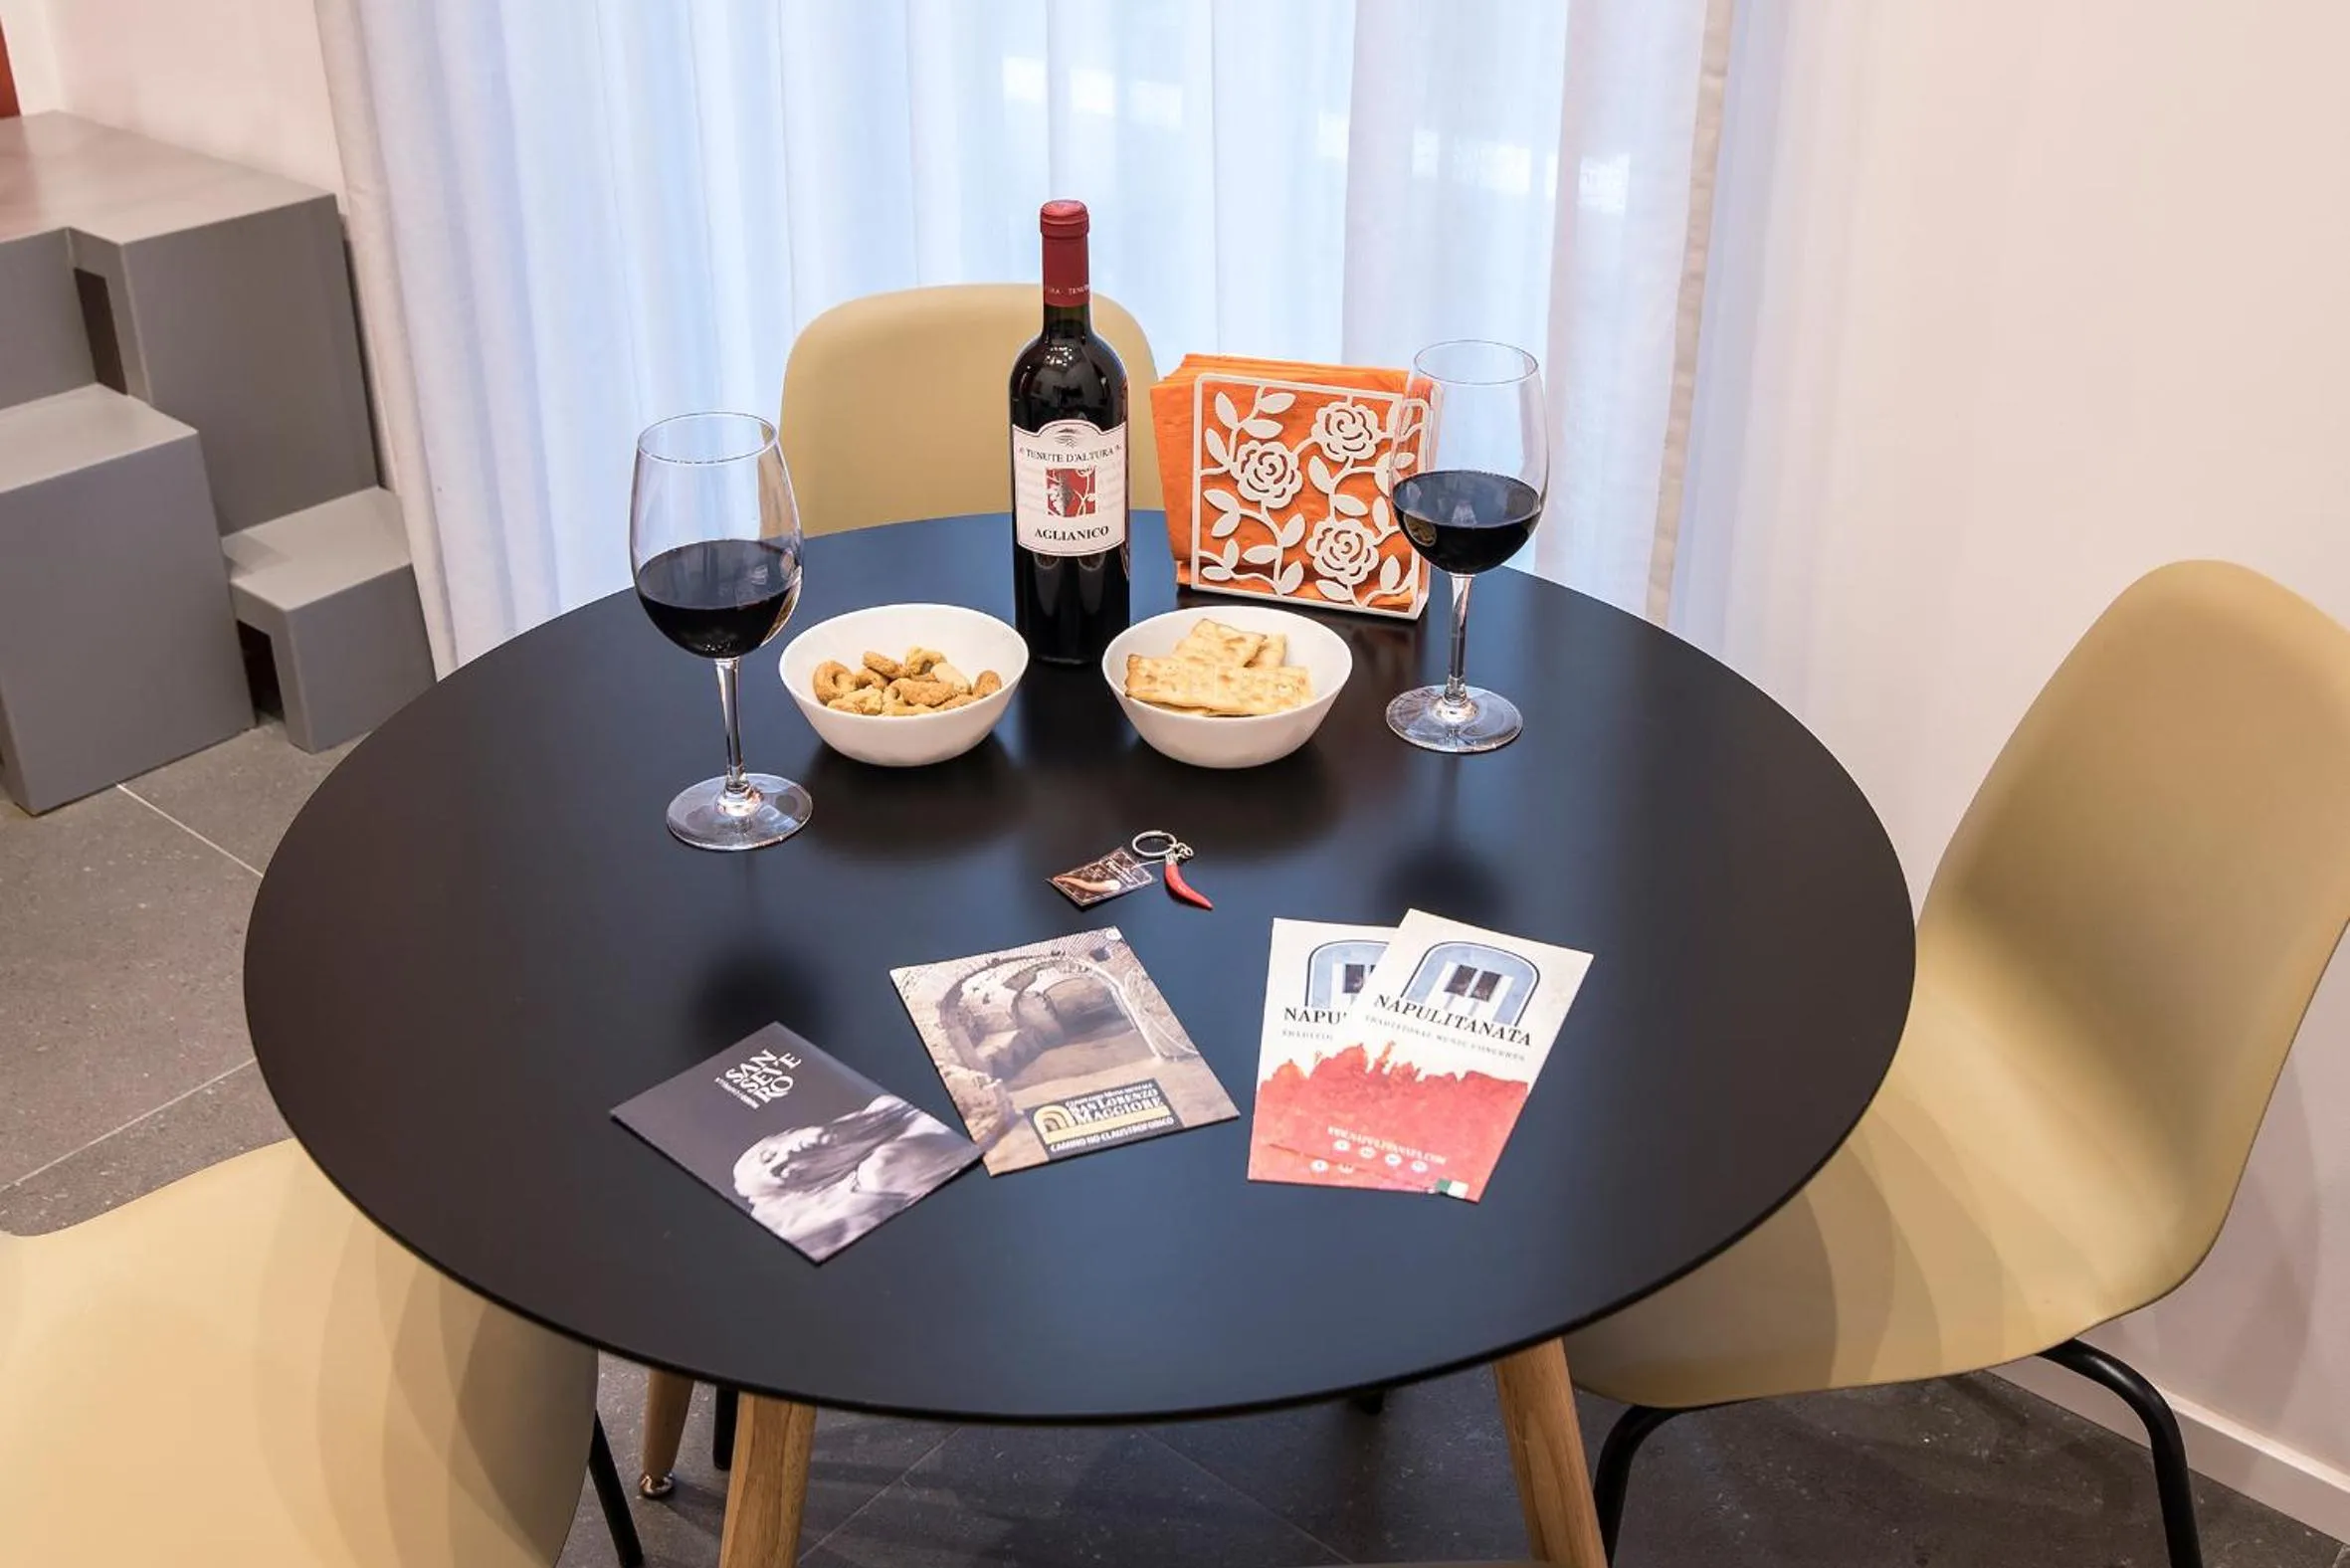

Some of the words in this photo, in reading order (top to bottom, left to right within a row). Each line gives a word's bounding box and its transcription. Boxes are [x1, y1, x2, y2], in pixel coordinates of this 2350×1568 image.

[1026, 449, 1064, 462] TENUTE
[1066, 449, 1114, 463] D'ALTURA
[1035, 525, 1109, 540] AGLIANICO
[1283, 1007, 1347, 1025] NAPU
[1373, 994, 1531, 1047] NAPULITANATA
[725, 1049, 777, 1082] SAN
[1069, 1100, 1096, 1113] SAN
[1095, 1087, 1158, 1109] LORENZO
[1073, 1096, 1164, 1125] MAGGIORE
